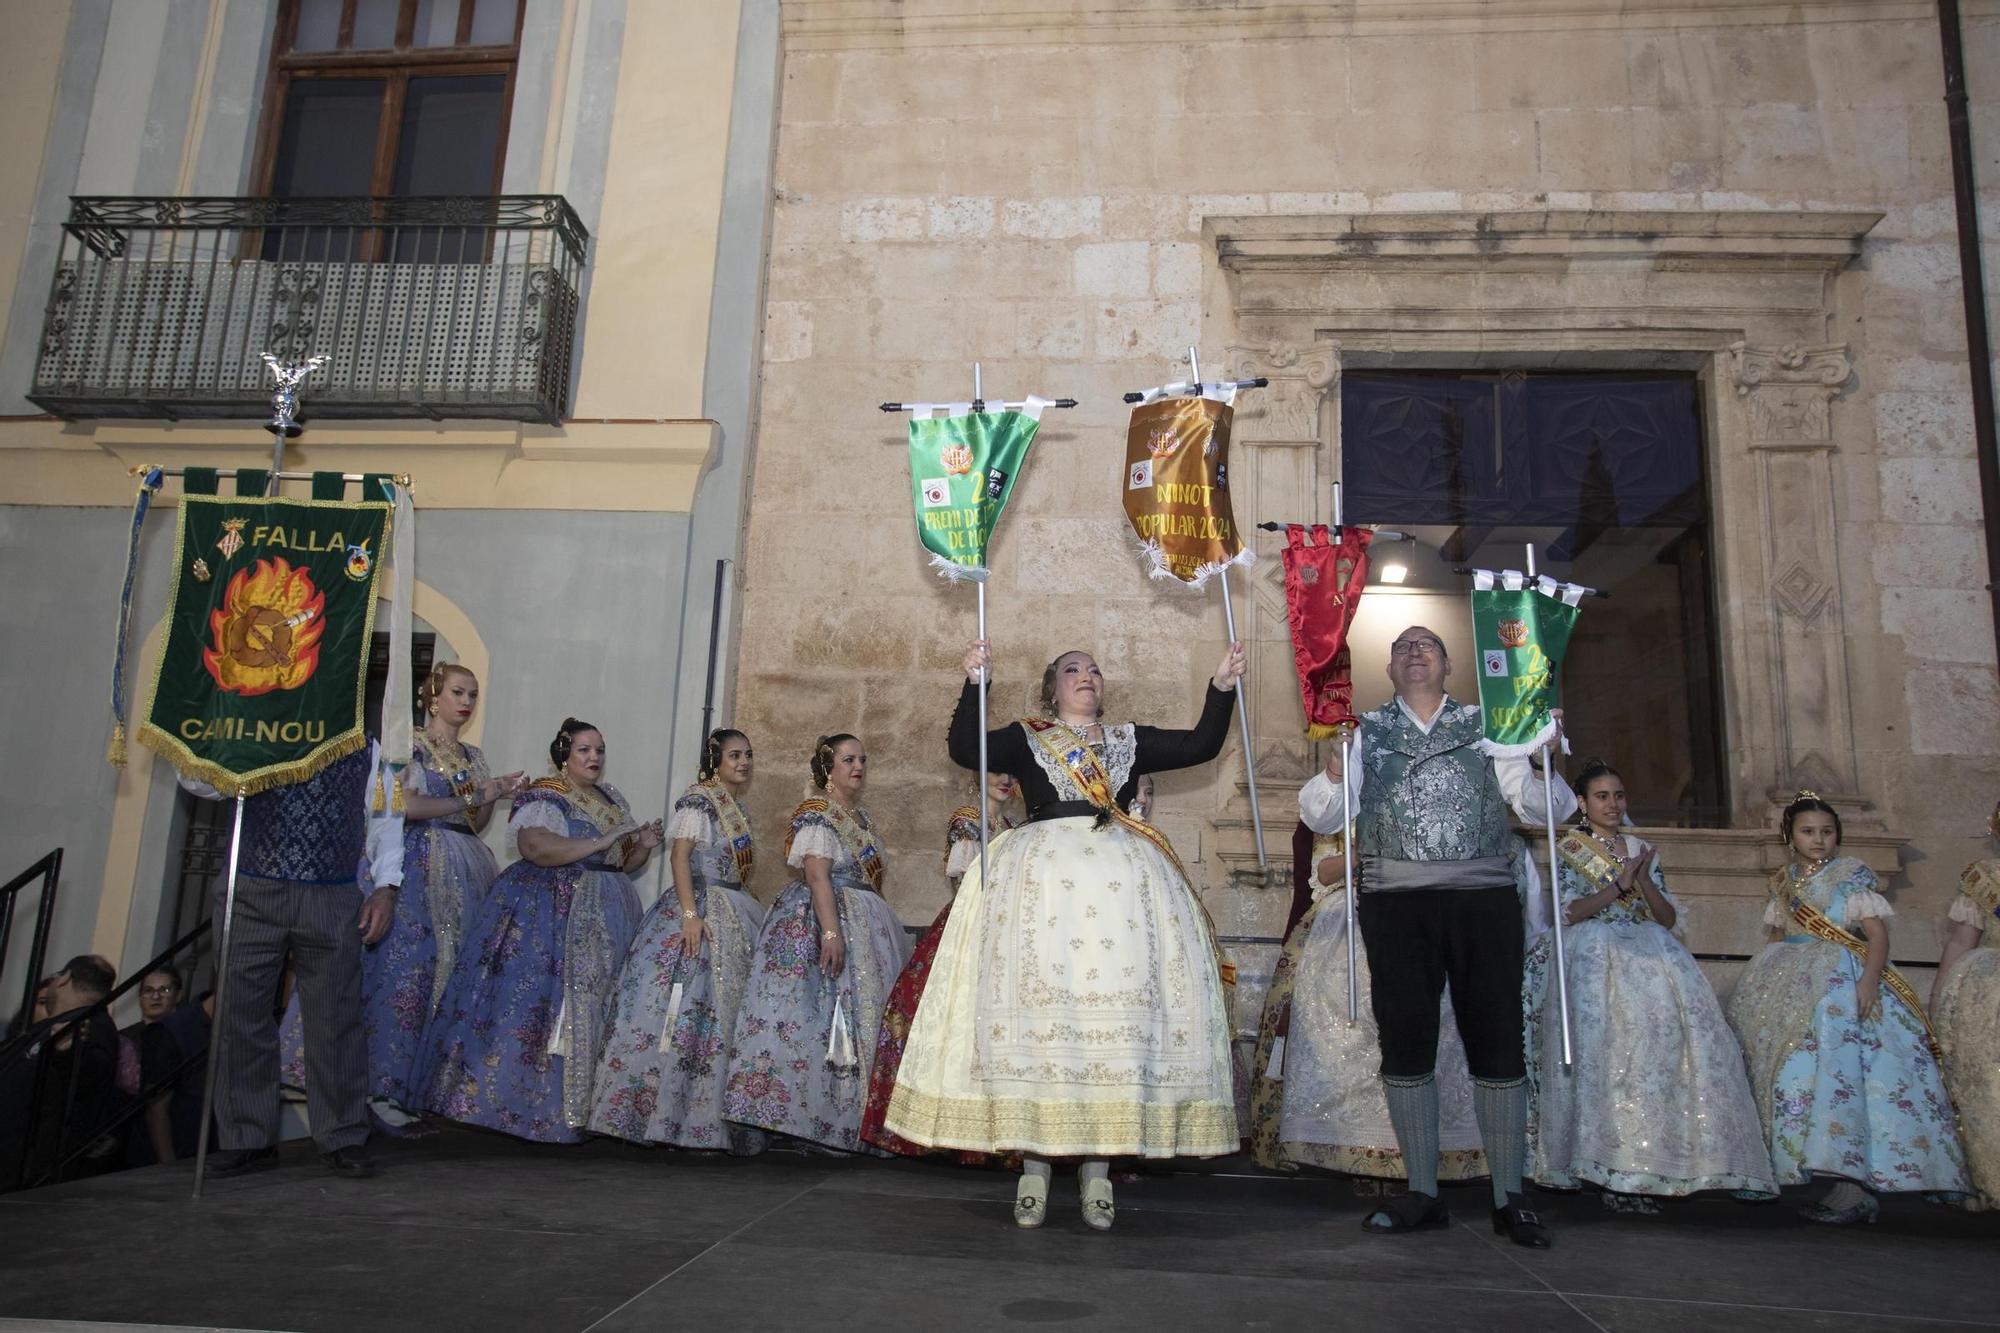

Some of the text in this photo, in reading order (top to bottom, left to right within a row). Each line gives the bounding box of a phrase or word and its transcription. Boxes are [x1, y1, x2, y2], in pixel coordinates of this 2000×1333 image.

[1157, 483, 1214, 508] NINOT
[925, 510, 961, 530] PREMI
[964, 508, 981, 528] DE
[1136, 513, 1231, 541] POPULAR 2024
[252, 526, 344, 553] FALLA
[949, 530, 965, 550] DE
[180, 717, 325, 743] CAMI-NOU
